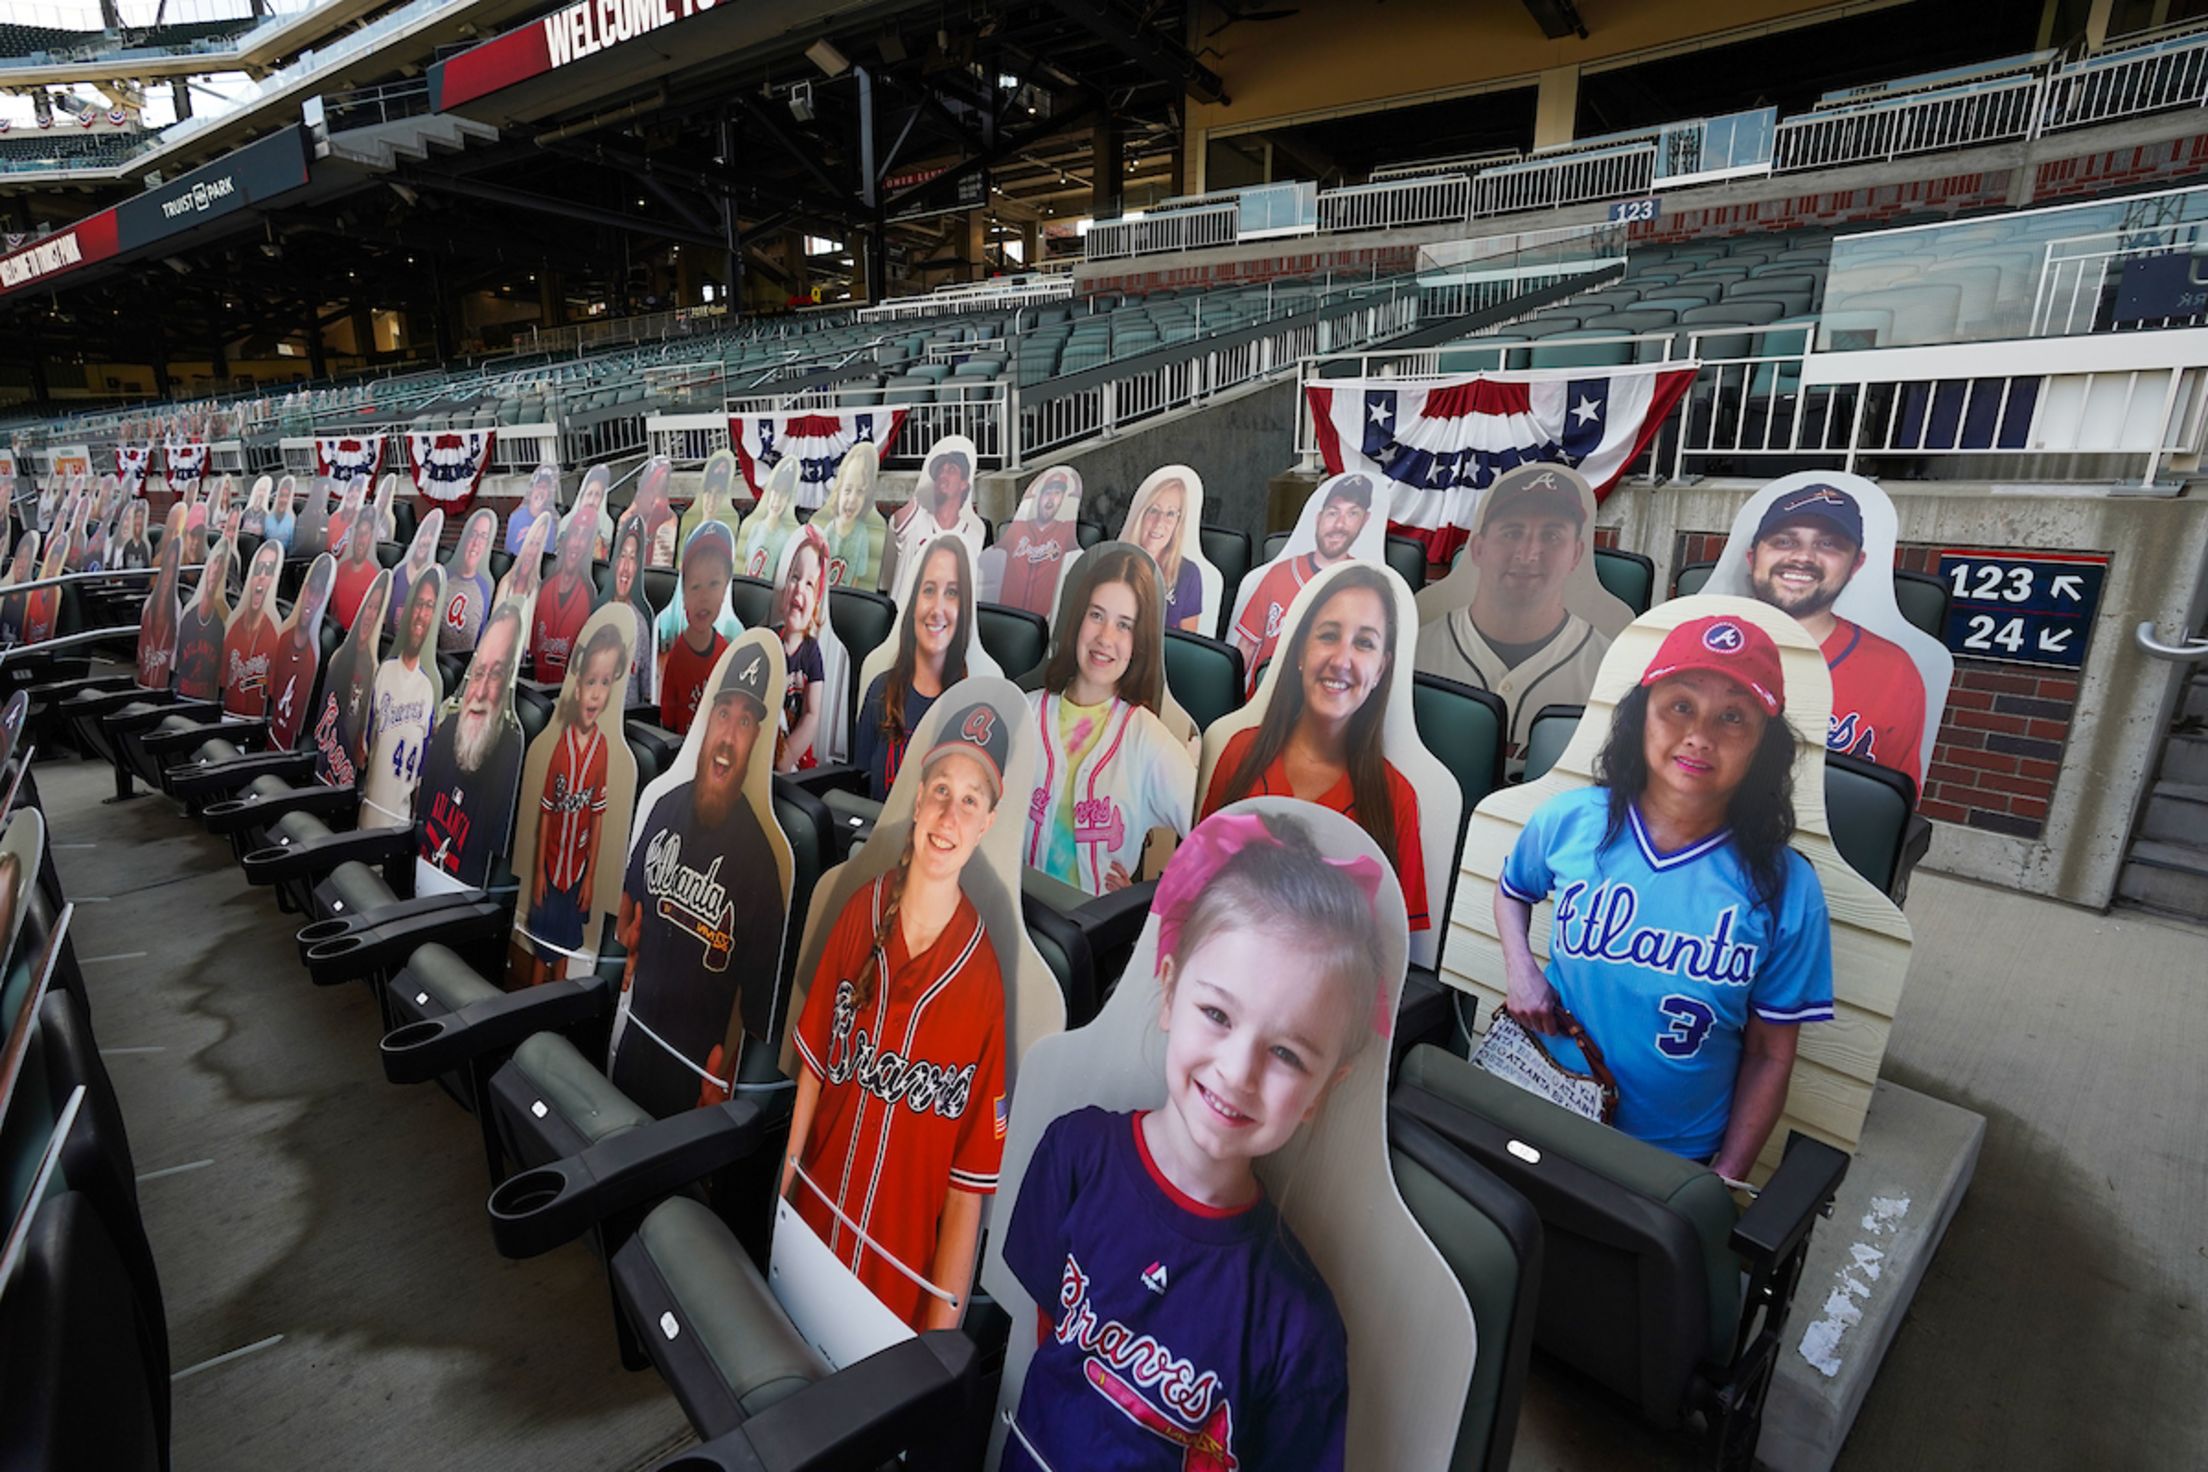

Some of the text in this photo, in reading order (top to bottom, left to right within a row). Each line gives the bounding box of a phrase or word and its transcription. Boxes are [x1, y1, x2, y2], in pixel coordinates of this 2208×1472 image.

[161, 176, 235, 218] TRUIST PARK
[1617, 200, 1653, 223] 123
[1950, 563, 2035, 603] 123
[1963, 614, 2026, 653] 24
[392, 738, 418, 783] 44
[1556, 877, 1759, 986] Atlanta
[1655, 993, 1718, 1059] 3
[827, 980, 977, 1119] Braves
[1055, 1252, 1219, 1424] Braves
